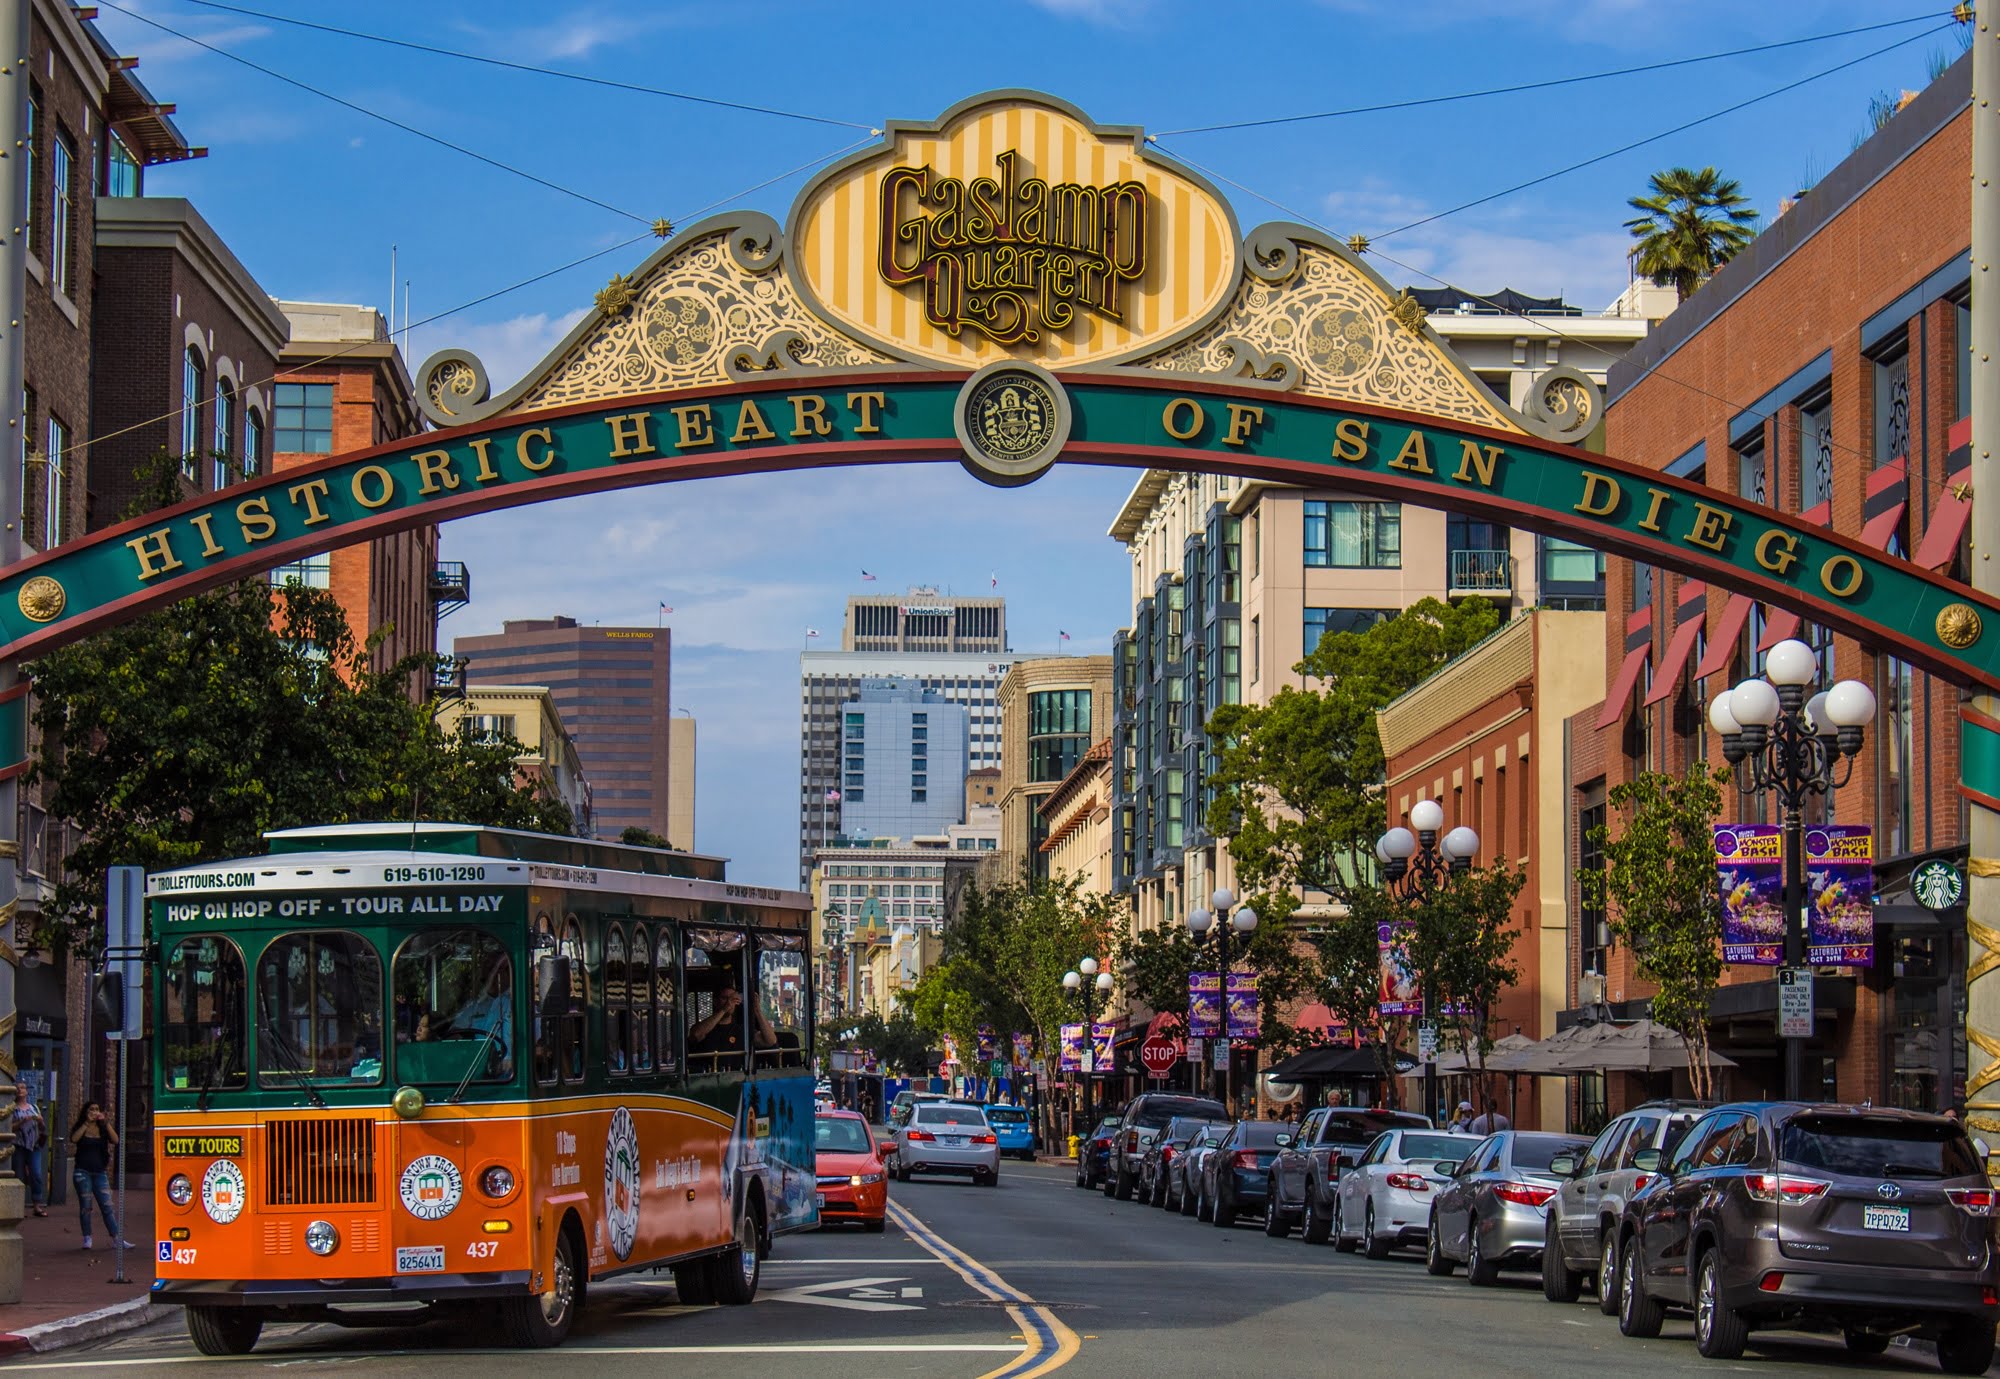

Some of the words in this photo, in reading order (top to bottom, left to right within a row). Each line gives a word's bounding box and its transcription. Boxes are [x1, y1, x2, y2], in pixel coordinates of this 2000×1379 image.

[878, 149, 1147, 320] Gaslamp
[924, 246, 1104, 344] Quarter
[1013, 378, 1036, 390] STATE
[1035, 388, 1045, 397] OF
[1043, 398, 1054, 440] CALIFORNIA
[126, 427, 555, 580] HISTORIC
[605, 392, 884, 458] HEART
[1162, 398, 1263, 446] OF
[1332, 419, 1505, 486] SAN
[1574, 471, 1863, 597] DIEGO
[908, 607, 954, 616] UnionBank
[631, 631, 654, 639] FARGO
[1739, 837, 1778, 847] MONSTER
[1830, 838, 1869, 847] MONSTER
[1741, 846, 1777, 857] BASH
[1832, 847, 1868, 857] BASH
[158, 873, 255, 891] TROLLEYTOURS.COM
[384, 867, 485, 882] 619-610-1290
[168, 904, 200, 922] HOP
[204, 903, 228, 920] ON
[232, 901, 273, 918] HOP
[279, 899, 322, 917] OFF
[341, 897, 404, 915] TOUR
[410, 896, 453, 913] ALL
[459, 895, 505, 913] DAY
[1726, 946, 1755, 955] SATURDAY
[1810, 948, 1842, 957] SATURDAY
[1785, 972, 1791, 984] 3
[1144, 1047, 1174, 1060] STOP
[167, 1138, 196, 1153] CITY
[199, 1138, 240, 1154] TOURS
[406, 1157, 431, 1177] TOWN
[605, 1140, 613, 1182] OLD
[207, 1160, 224, 1180] TOWN
[434, 1157, 462, 1193] TROLLEY
[226, 1161, 245, 1199] TROLLEY
[401, 1177, 412, 1196] OLD
[203, 1180, 212, 1198] OLD
[208, 1203, 240, 1223] TOURS
[410, 1199, 455, 1219] TOURS
[1866, 1212, 1907, 1229] 7PPD792
[175, 1248, 198, 1265] 437
[466, 1241, 499, 1258] 437
[399, 1254, 443, 1269] 82564Y1
